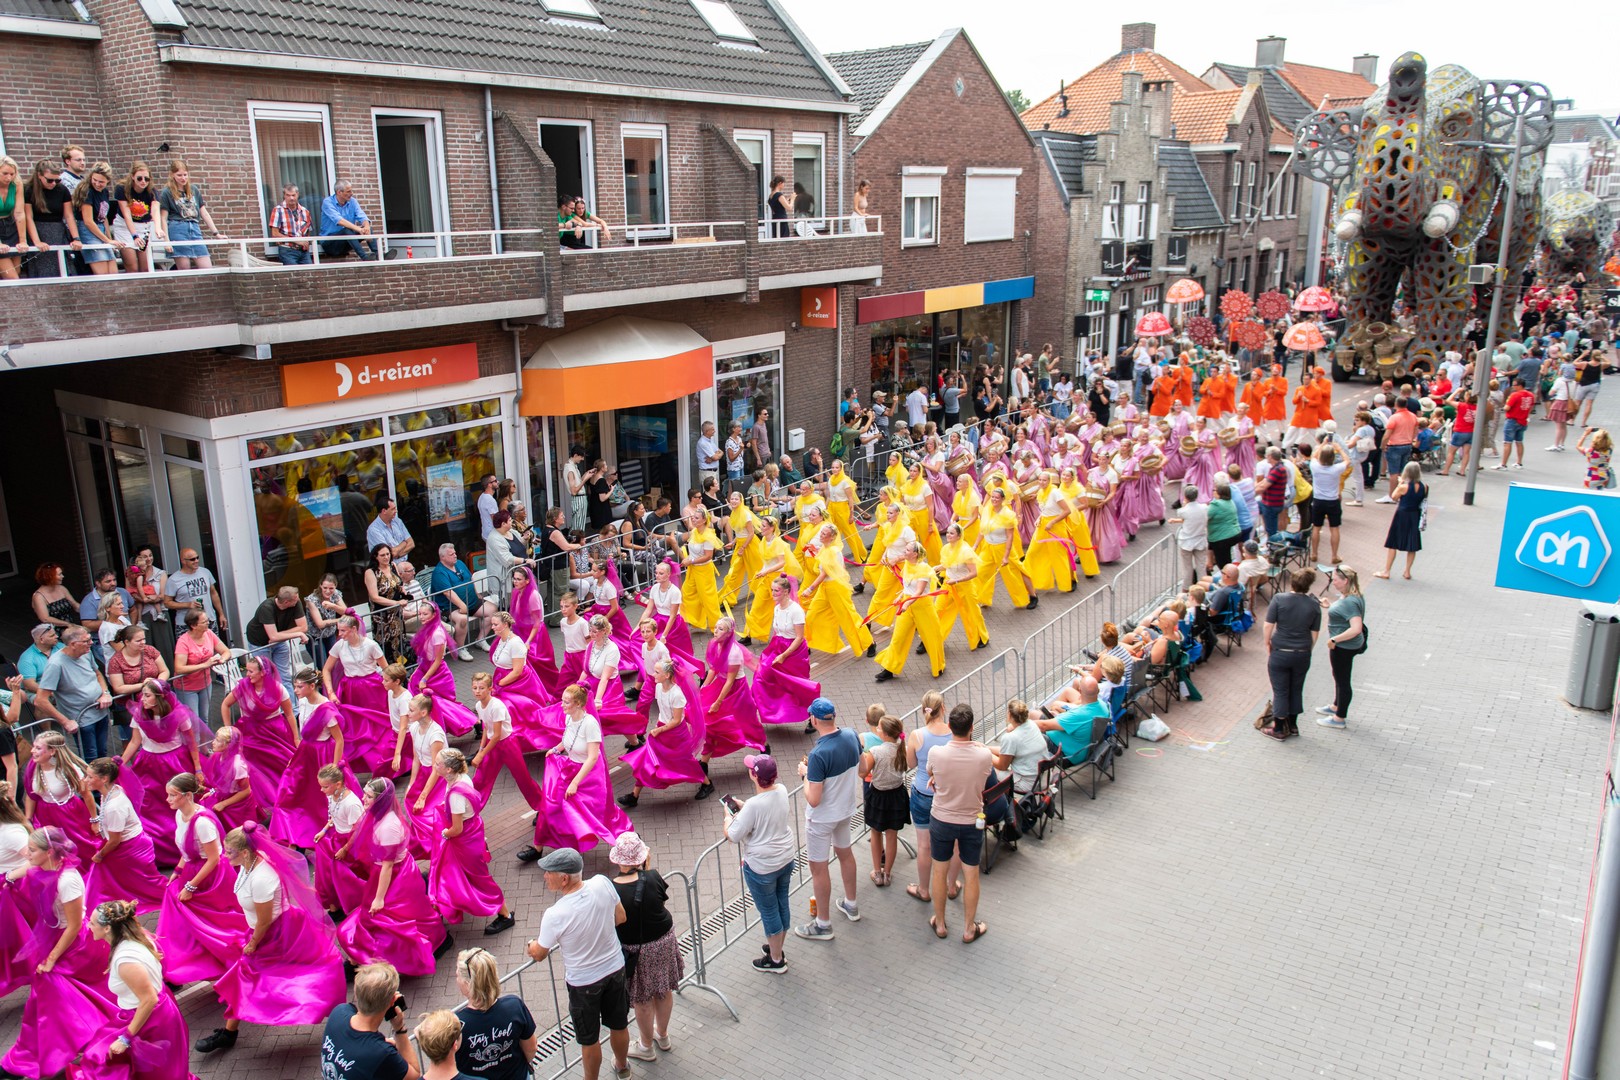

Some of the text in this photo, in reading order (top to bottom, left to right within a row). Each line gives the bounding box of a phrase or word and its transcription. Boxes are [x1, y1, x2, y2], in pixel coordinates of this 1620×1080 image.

[468, 1021, 513, 1048] Stay Kool
[335, 1049, 355, 1071] Kool
